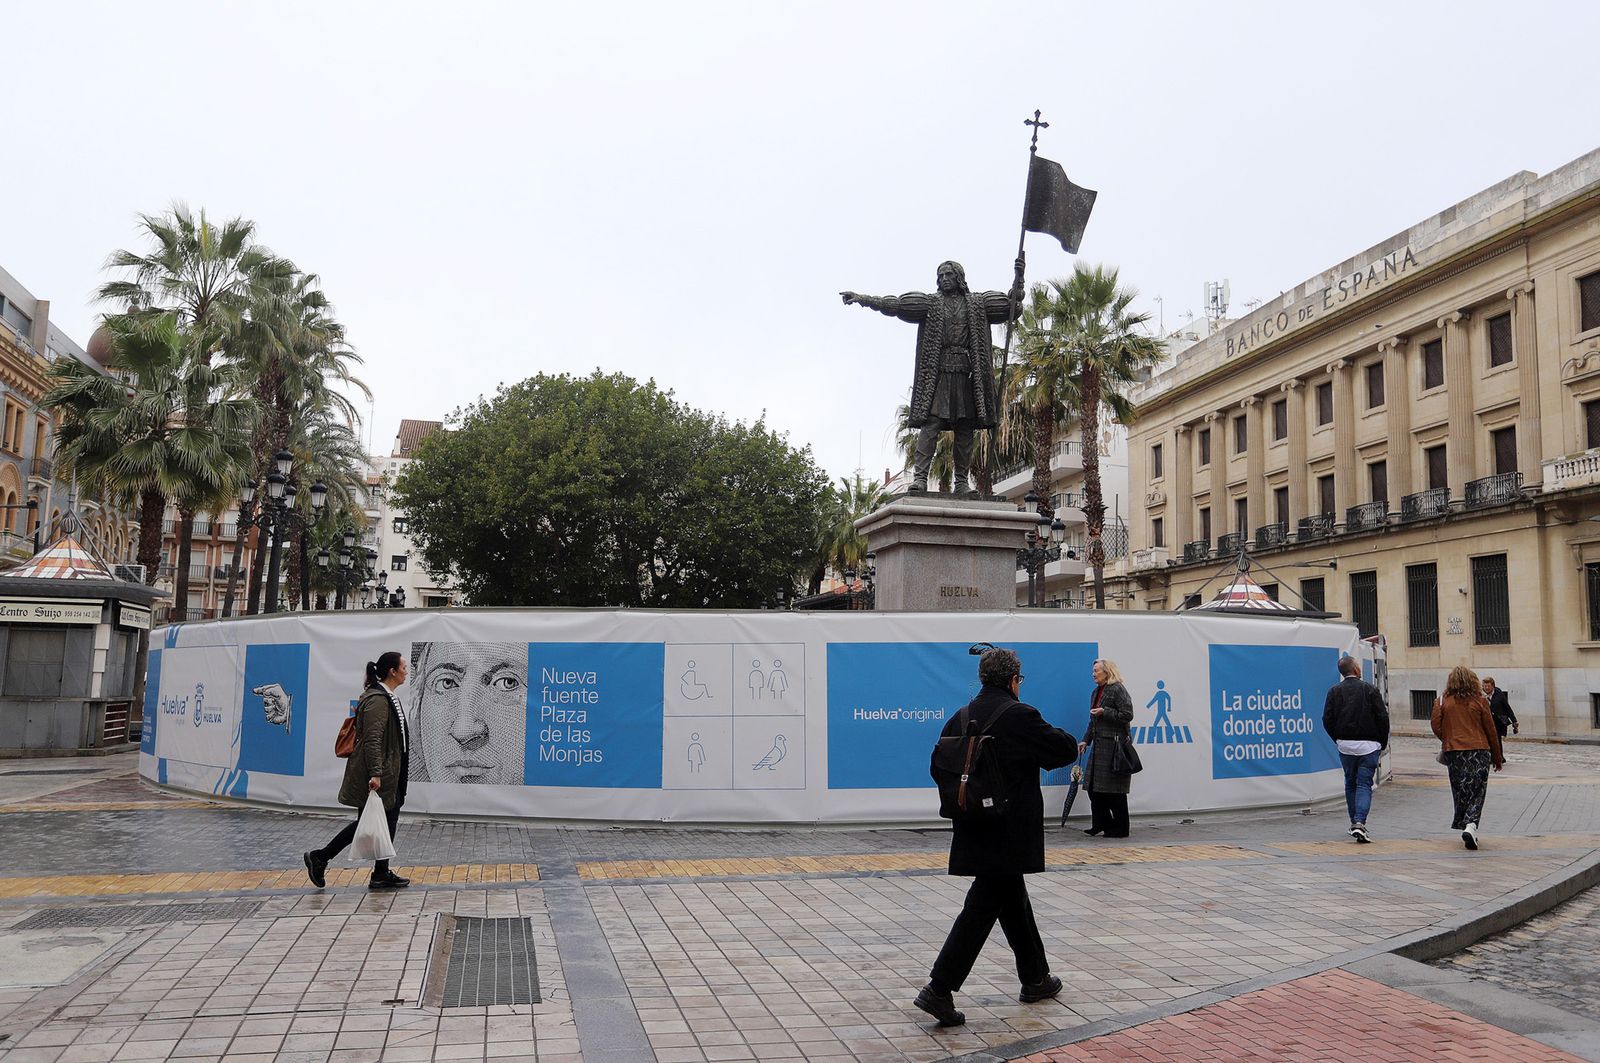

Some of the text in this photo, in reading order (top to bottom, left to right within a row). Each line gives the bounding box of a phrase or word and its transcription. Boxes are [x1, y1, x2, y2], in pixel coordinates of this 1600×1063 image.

[1226, 311, 1289, 359] BANCO
[1323, 246, 1419, 311] ESPAÑA
[940, 586, 979, 597] HUELVA
[0, 605, 28, 616] Centro
[34, 606, 62, 620] Suizo
[542, 667, 597, 684] Nueva
[541, 686, 599, 704] fuente
[1222, 689, 1302, 711] La ciudad
[541, 705, 587, 723] Plaza
[540, 724, 591, 743] de las
[1223, 712, 1313, 736] donde todo
[539, 744, 603, 767] Monjas
[1223, 738, 1303, 761] comienza
